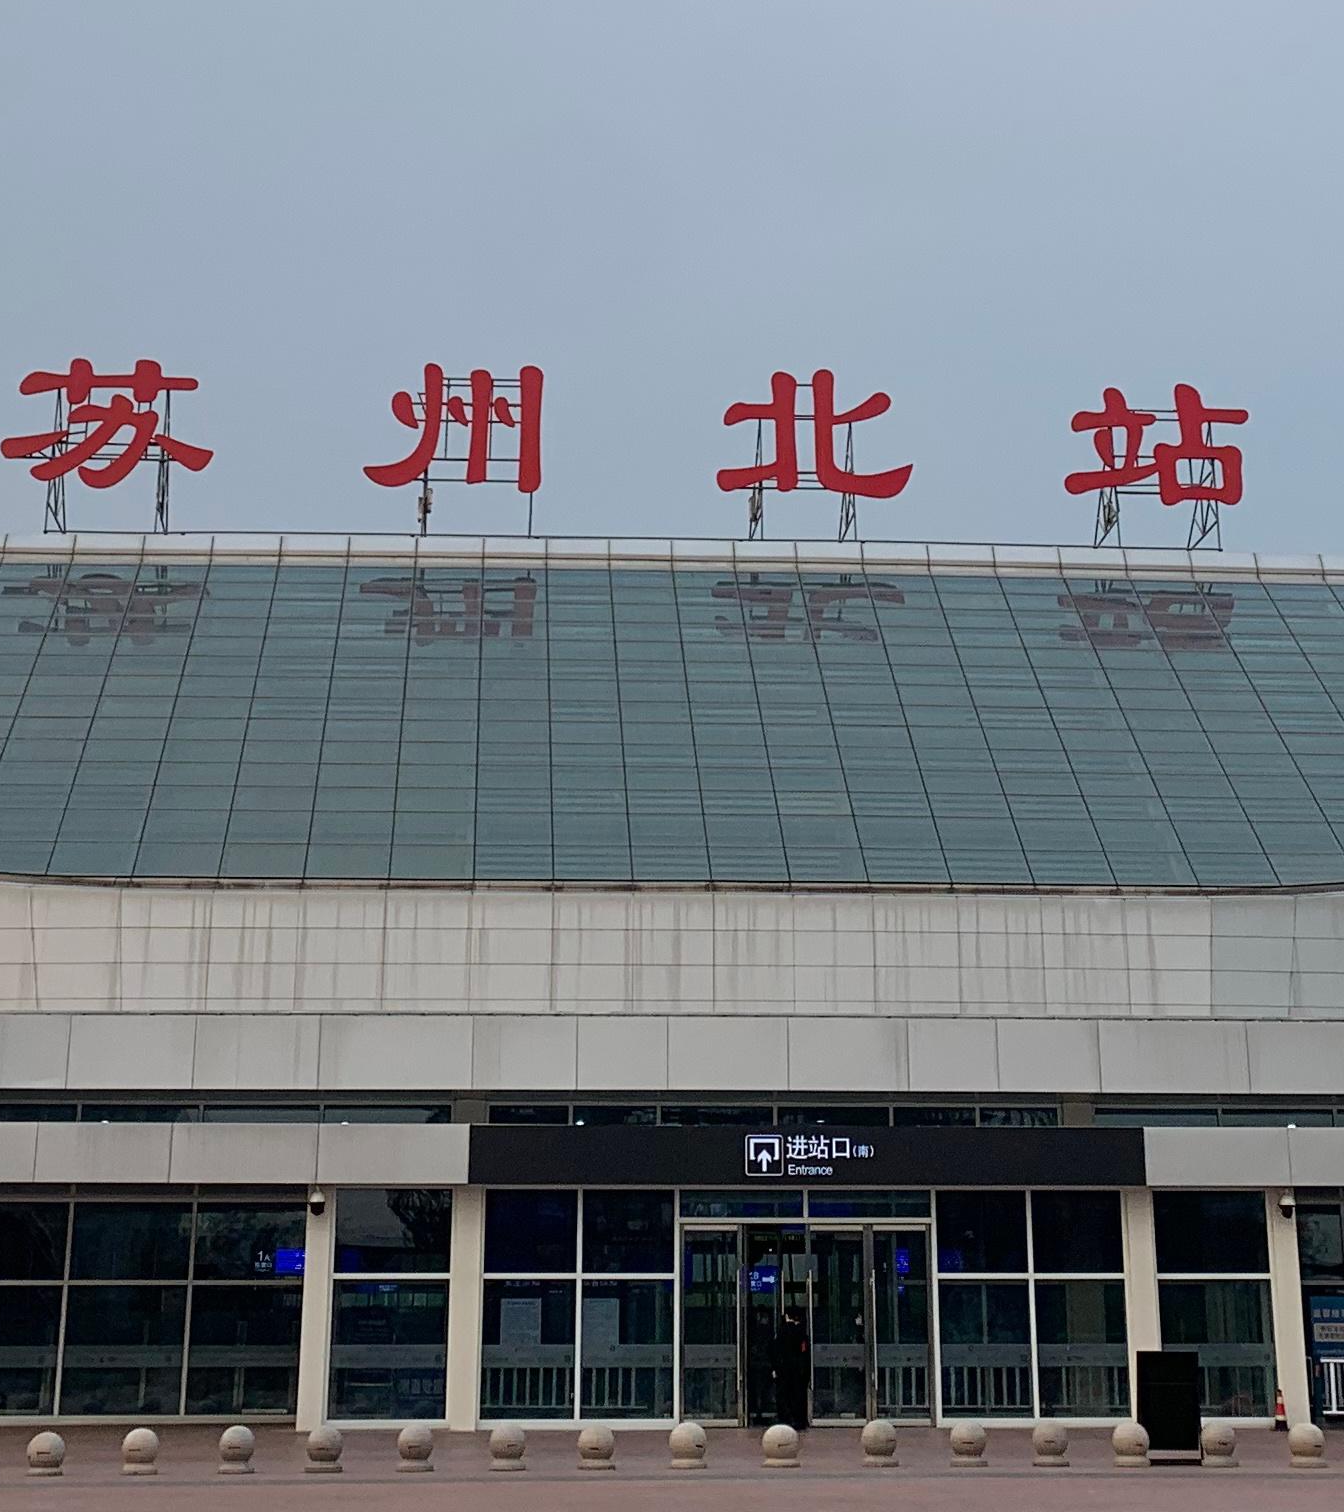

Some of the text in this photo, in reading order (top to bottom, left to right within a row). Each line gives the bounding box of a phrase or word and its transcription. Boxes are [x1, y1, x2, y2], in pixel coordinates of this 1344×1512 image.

[0, 357, 1249, 505] 苏州北站
[787, 1163, 834, 1176] Entrance
